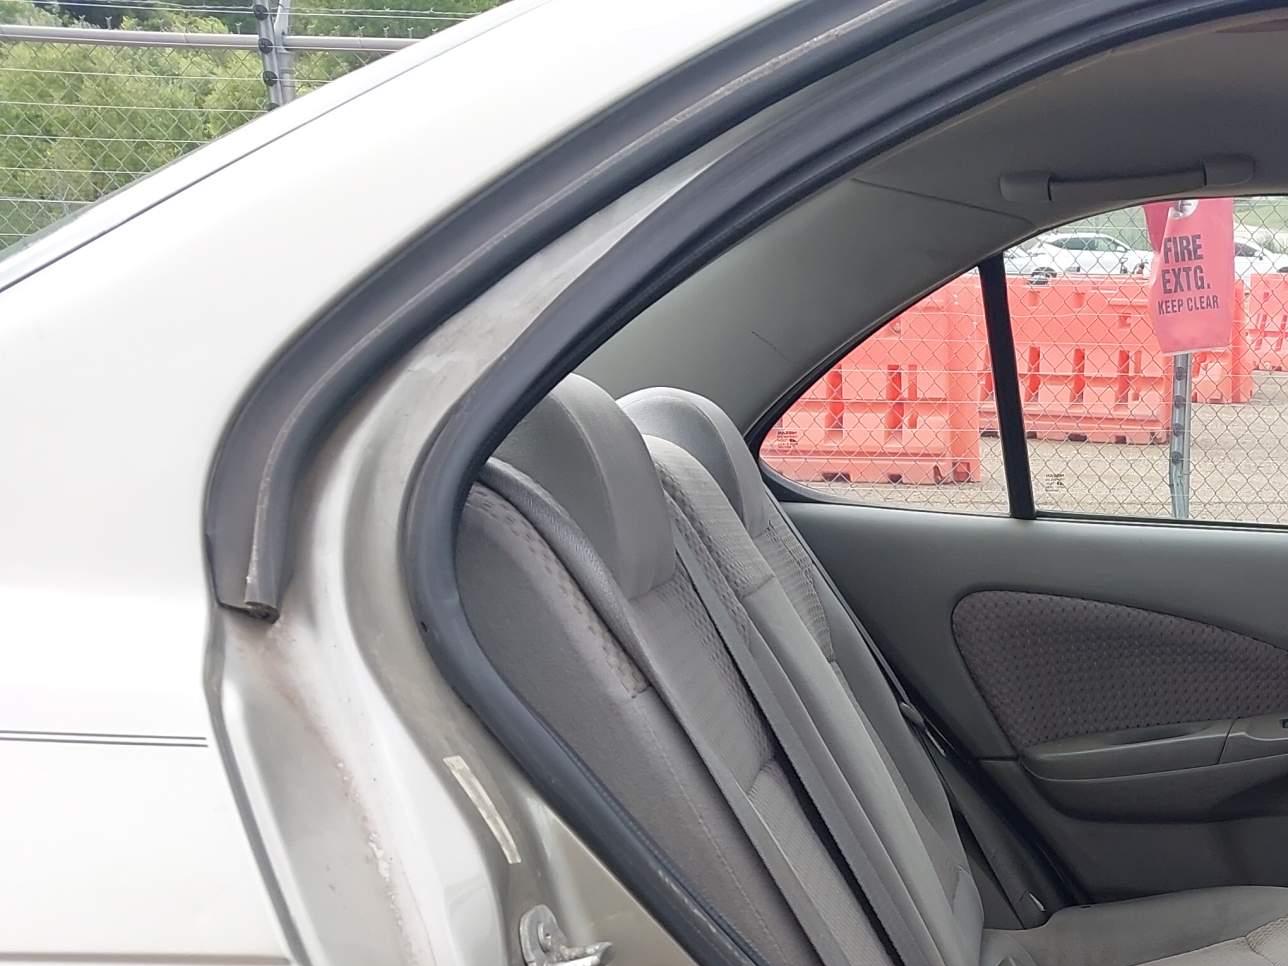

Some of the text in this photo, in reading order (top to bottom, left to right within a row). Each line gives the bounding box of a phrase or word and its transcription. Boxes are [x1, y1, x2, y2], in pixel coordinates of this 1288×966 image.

[1163, 234, 1204, 264] FIRE
[1161, 265, 1211, 293] EXTG.
[1158, 295, 1219, 316] KEEP CLEAR
